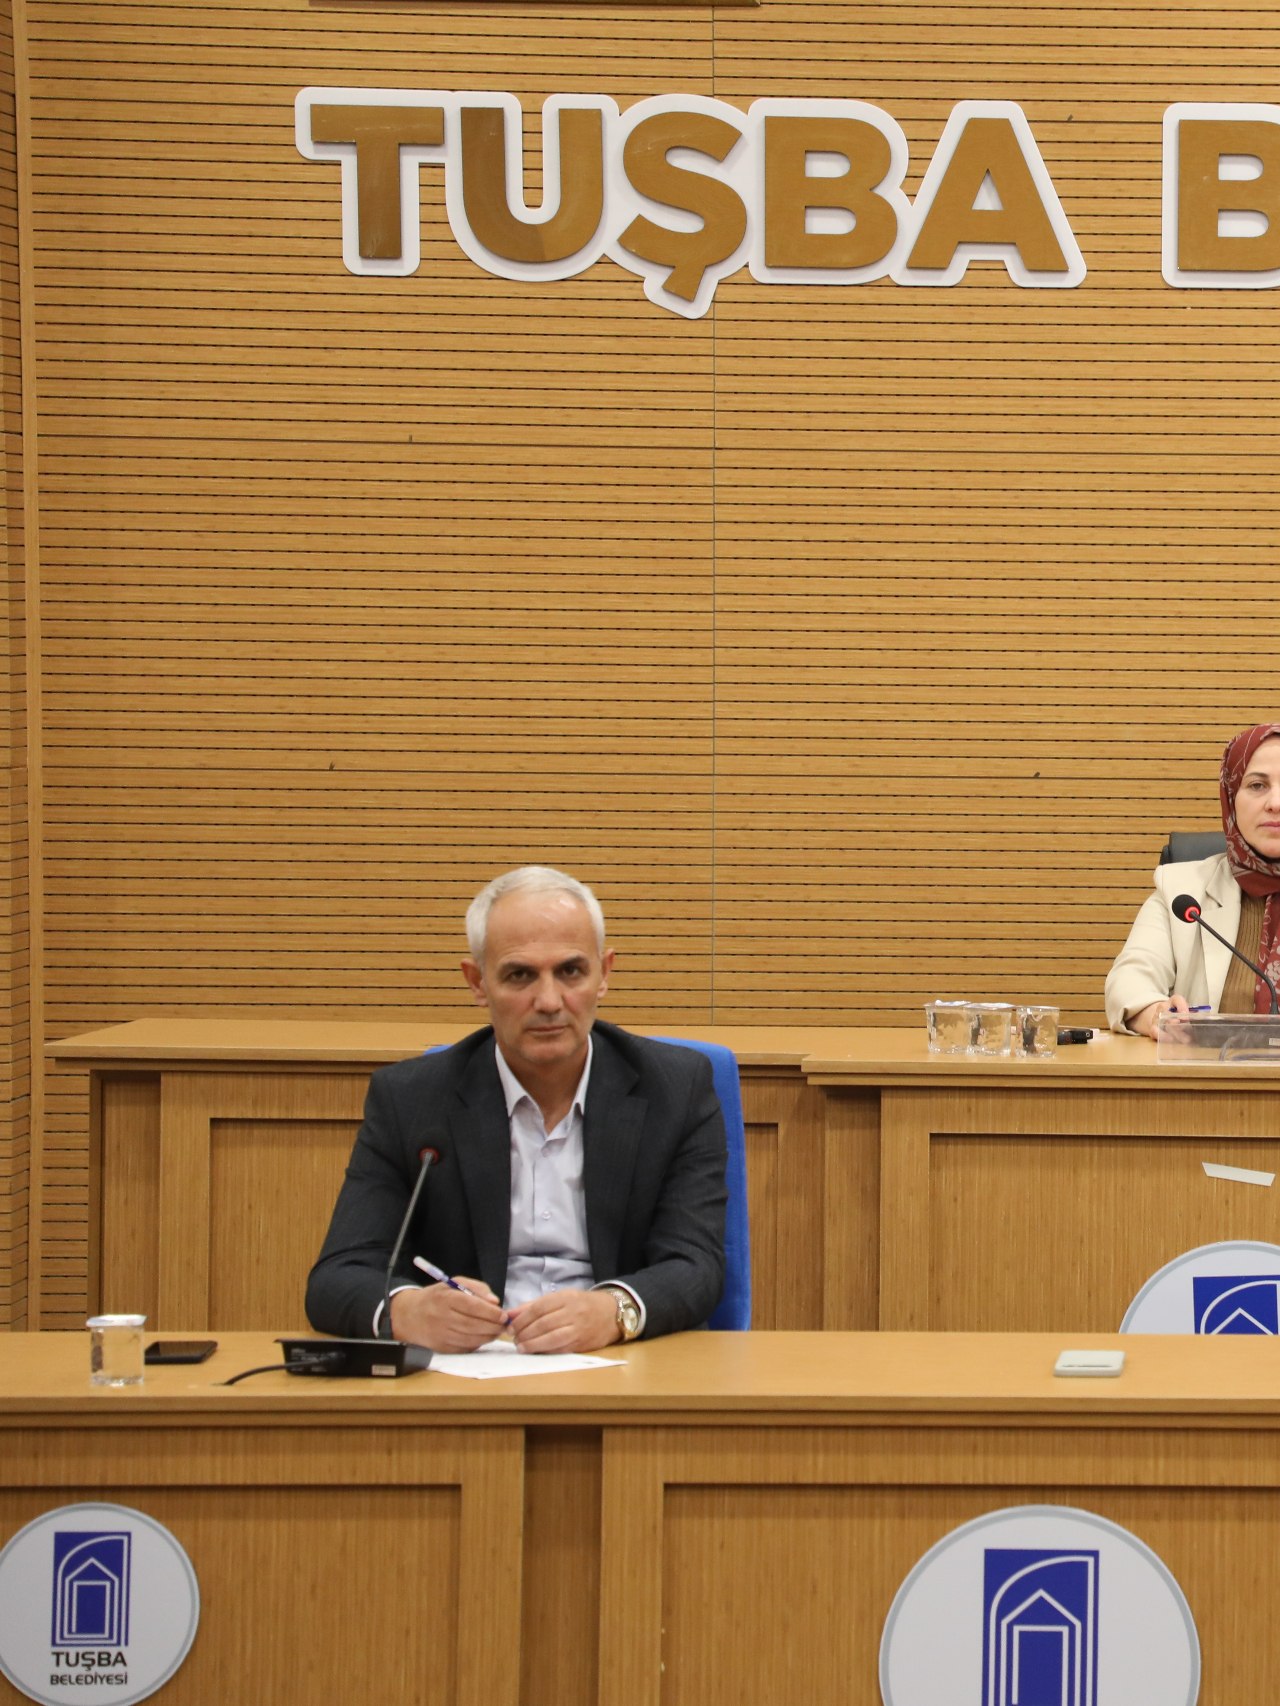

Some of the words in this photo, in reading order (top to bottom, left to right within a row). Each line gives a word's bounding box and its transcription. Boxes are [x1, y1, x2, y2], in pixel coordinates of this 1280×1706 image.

[310, 103, 1069, 303] TUŞBA
[51, 1651, 127, 1671] TUŞBA
[50, 1671, 128, 1685] BELEDİYESİ
